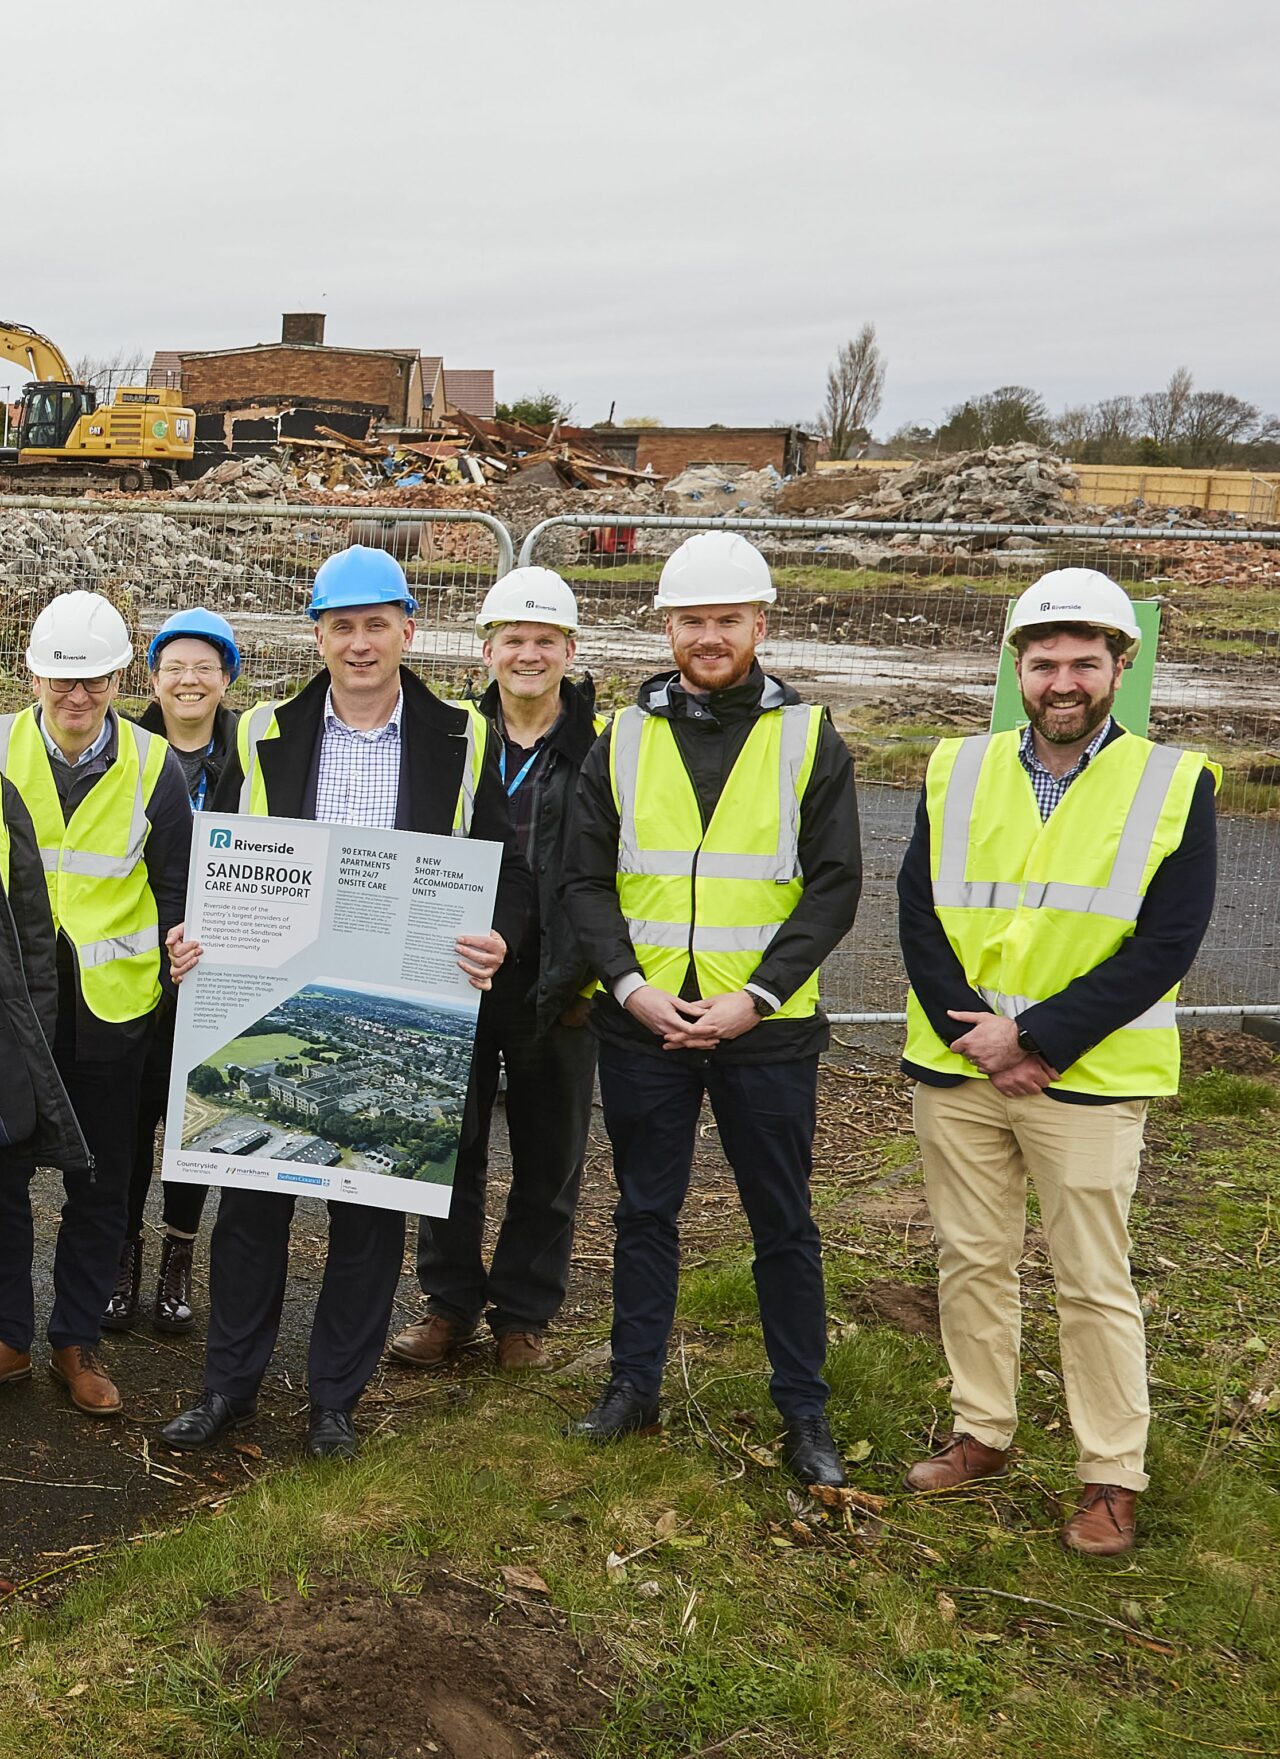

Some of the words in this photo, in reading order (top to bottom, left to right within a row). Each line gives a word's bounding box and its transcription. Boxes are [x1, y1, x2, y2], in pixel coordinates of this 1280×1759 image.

[89, 426, 101, 435] CAT
[176, 419, 188, 438] CAT
[234, 839, 294, 855] Riverside
[342, 847, 351, 855] 90
[353, 848, 377, 858] EXTRA
[378, 852, 398, 860] CARE
[340, 857, 390, 870] APARTMENTS
[416, 856, 421, 864] 8
[422, 857, 441, 866] NEW
[206, 862, 312, 885] SANDBROOK
[340, 867, 360, 876] WITH
[362, 870, 379, 879] 24/7
[415, 867, 464, 879] SHORT-TERM
[205, 880, 232, 891] CARE
[235, 882, 258, 893] AND
[261, 885, 310, 898] SUPPORT
[338, 877, 366, 888] ONSITE
[368, 881, 387, 891] CARE
[413, 877, 484, 893] ACCOMMODATION
[412, 888, 436, 897] UNITS
[177, 1160, 218, 1170] Countryside
[237, 1168, 269, 1176] markhams
